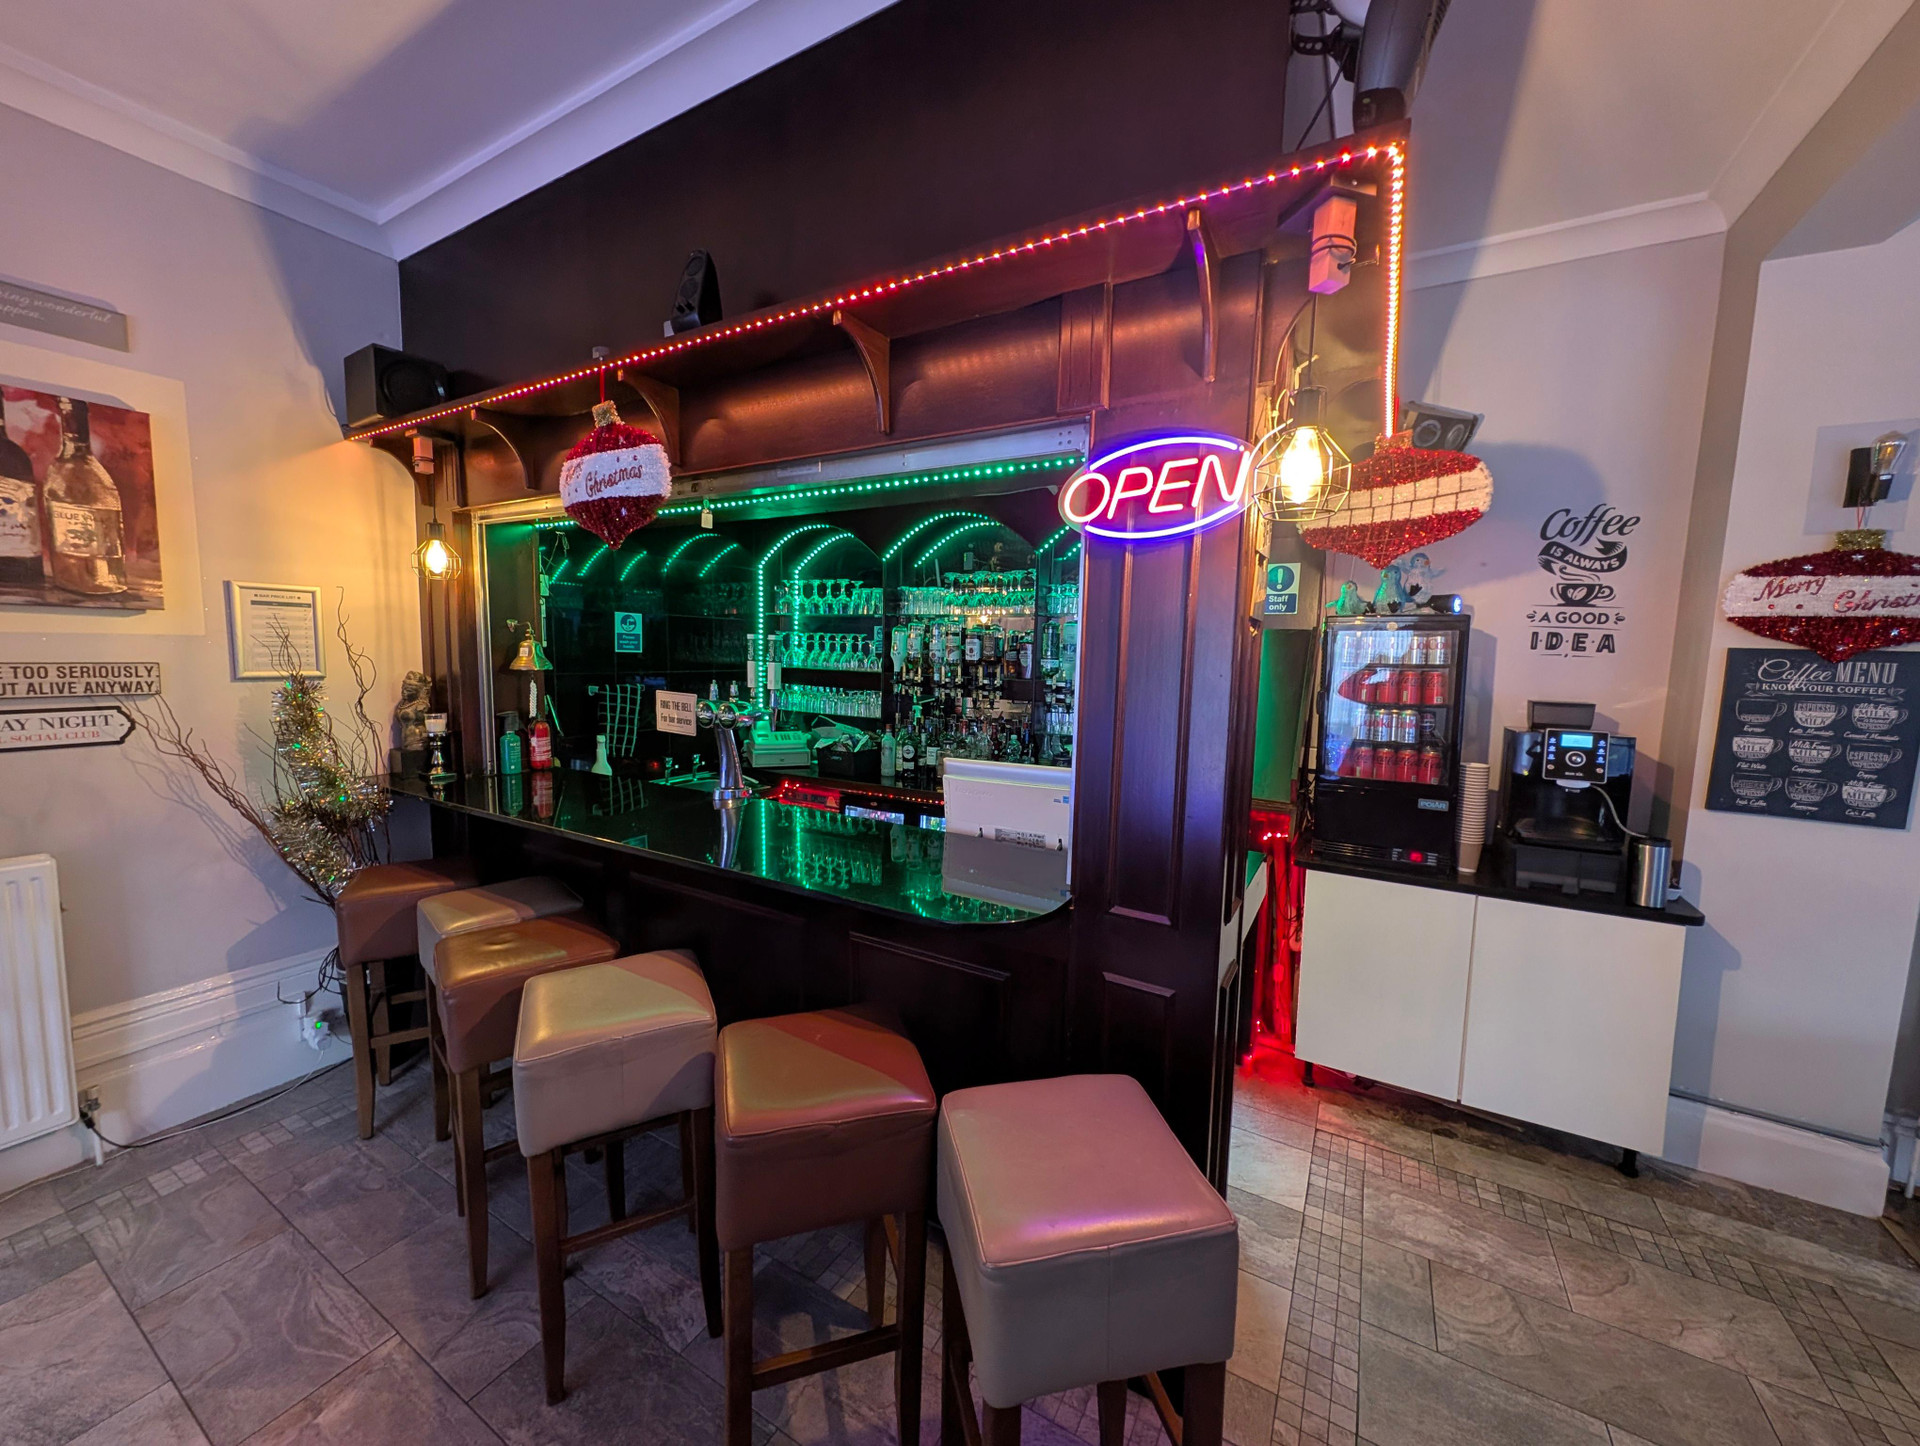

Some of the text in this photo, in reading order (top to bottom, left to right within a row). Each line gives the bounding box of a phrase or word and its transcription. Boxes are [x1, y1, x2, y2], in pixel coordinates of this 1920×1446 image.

[33, 300, 112, 322] wonderful
[585, 465, 643, 498] Christmas
[1063, 450, 1250, 522] OPEN
[1540, 503, 1641, 546] Coffee
[1550, 545, 1620, 570] IS ALWAYS
[1753, 577, 1827, 602] Merry
[1538, 612, 1610, 625] A GOOD
[10, 666, 48, 679] TOO
[1757, 658, 1899, 688] Coffee MENU
[26, 682, 77, 695] ALIVE
[1762, 683, 1887, 695] KNOW YOUR COFFEE
[672, 702, 680, 711] THE
[681, 703, 692, 712] BELL
[1, 714, 115, 732] AY NIGHT
[10, 733, 62, 744] SOCIAL
[65, 730, 101, 740] CLUB
[1736, 744, 1767, 752] MILK
[1793, 749, 1825, 757] MILK
[1847, 792, 1880, 802] MILK
[1420, 801, 1447, 809] POLAR
